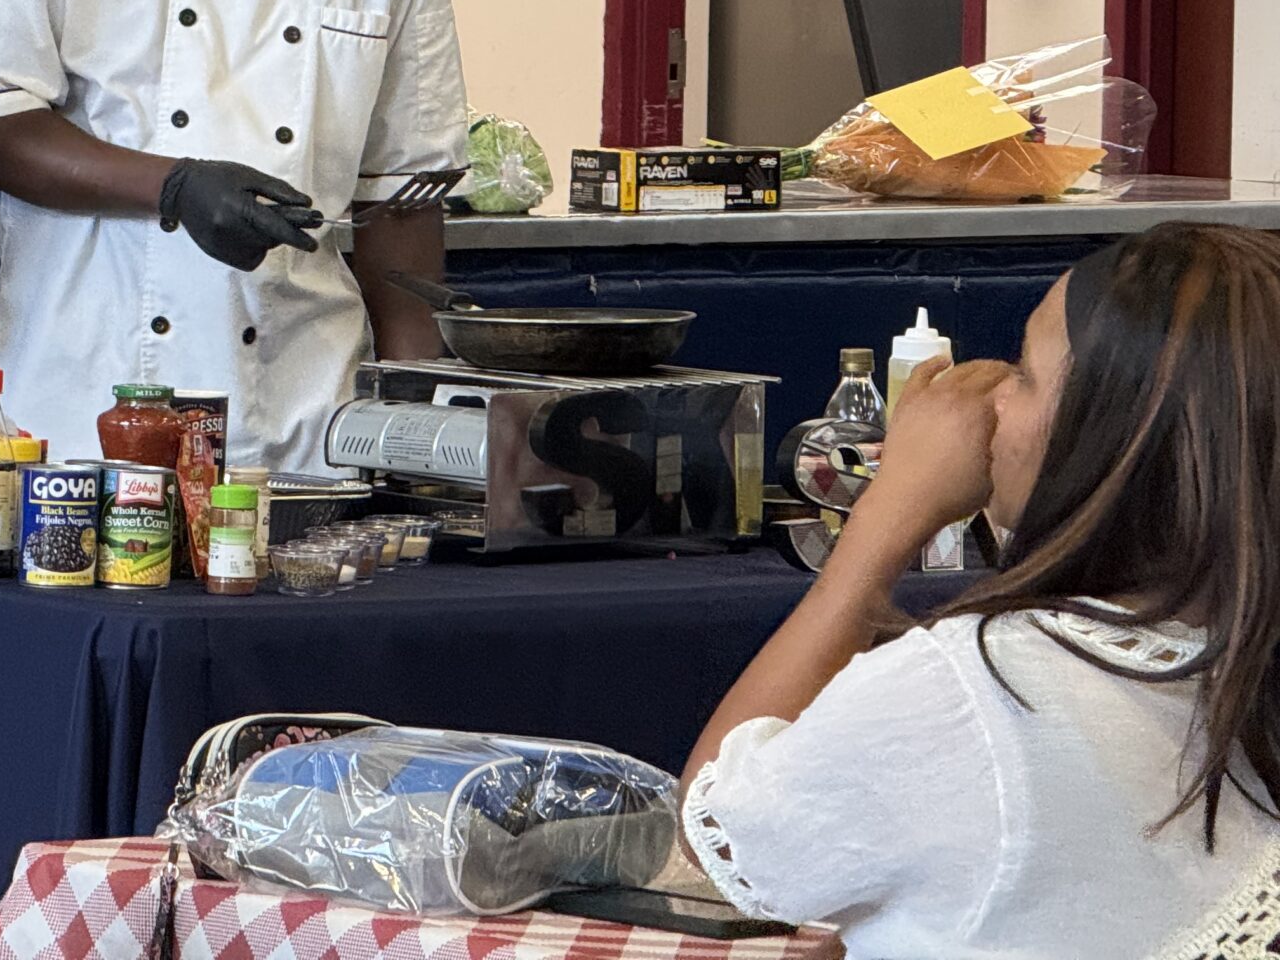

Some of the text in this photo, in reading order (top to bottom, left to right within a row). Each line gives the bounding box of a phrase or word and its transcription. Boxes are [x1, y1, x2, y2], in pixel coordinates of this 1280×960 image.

[573, 155, 600, 169] RAVEN
[639, 163, 688, 180] RAVEN
[32, 476, 96, 499] GOYA
[123, 479, 159, 496] Libby's
[41, 506, 89, 516] Black Beans
[111, 506, 166, 517] Whole Kernel
[36, 514, 66, 526] Frijoles
[105, 516, 169, 530] Sweet Corn
